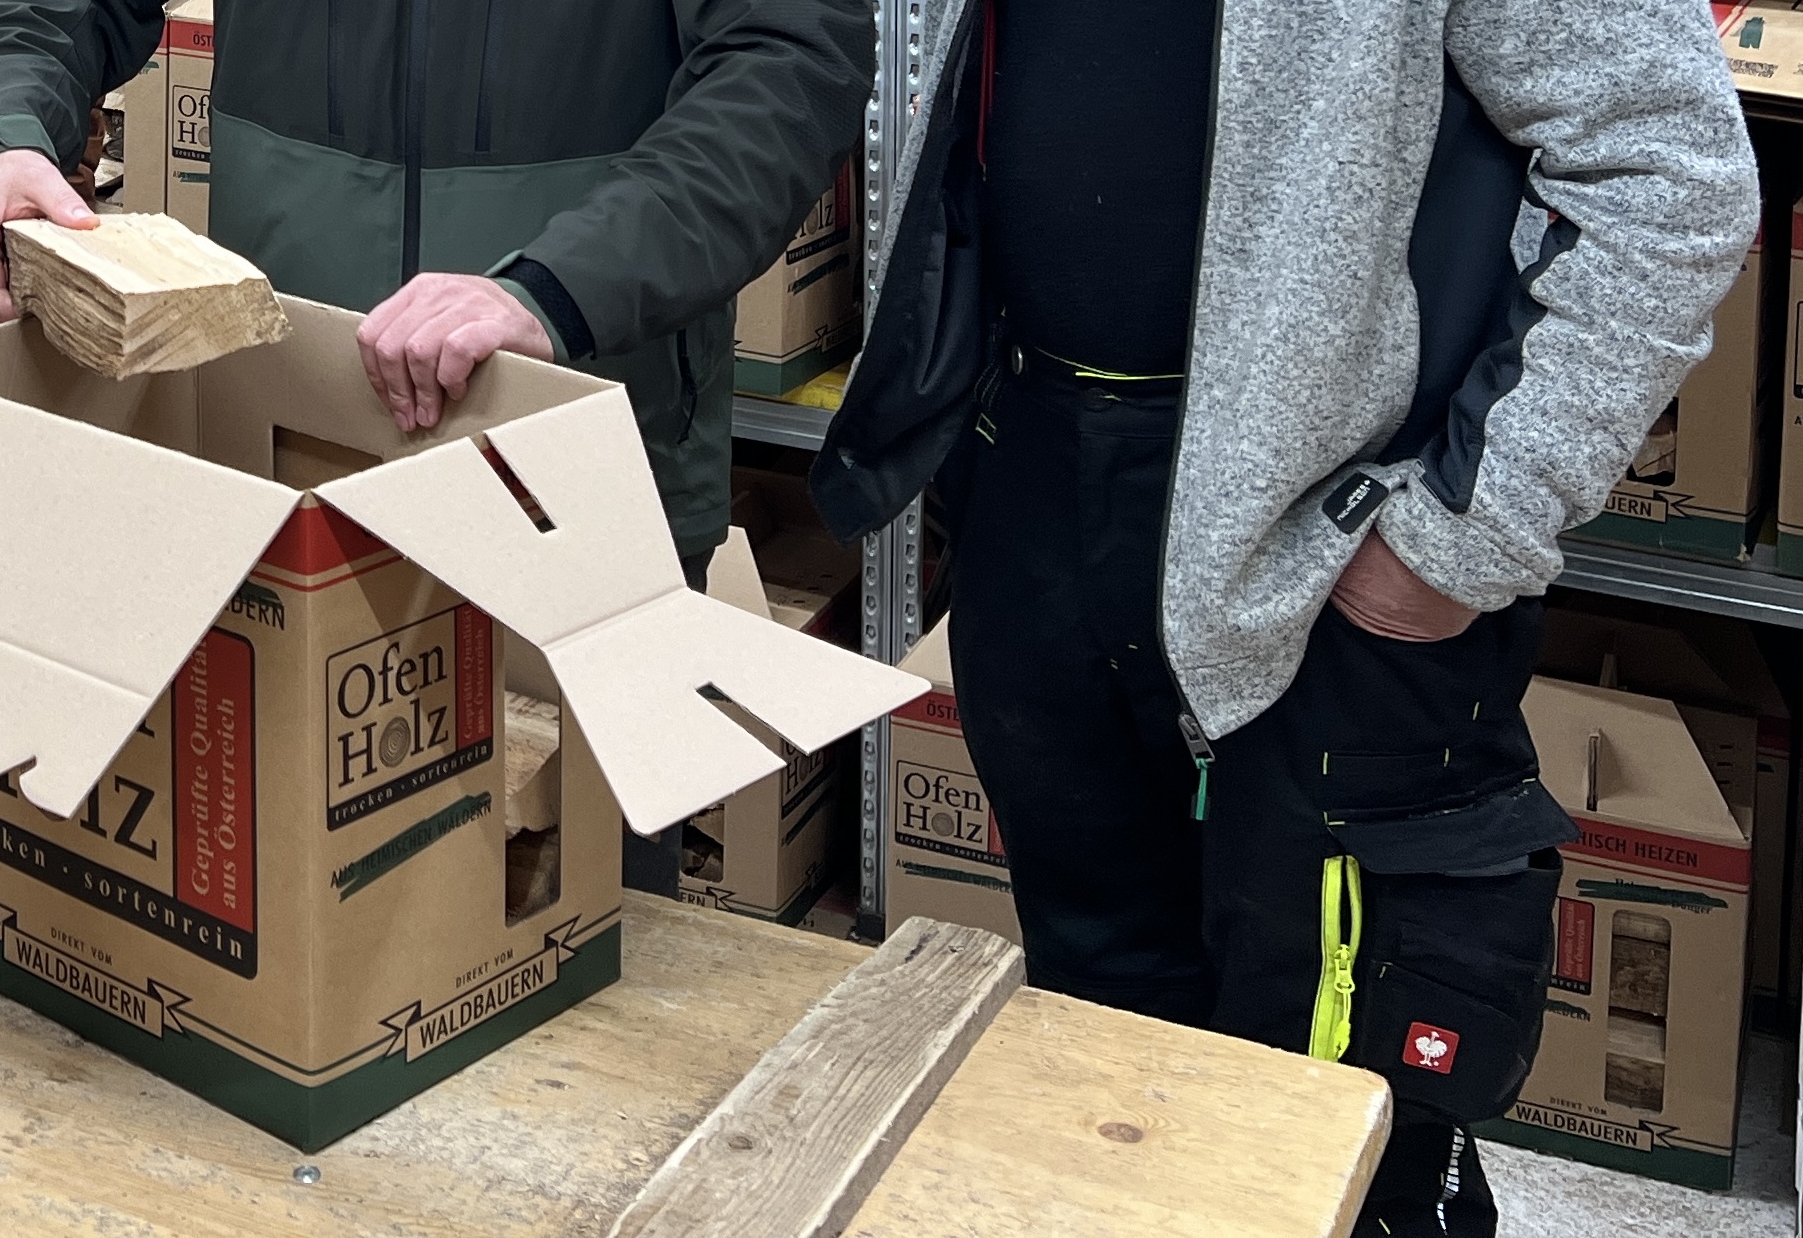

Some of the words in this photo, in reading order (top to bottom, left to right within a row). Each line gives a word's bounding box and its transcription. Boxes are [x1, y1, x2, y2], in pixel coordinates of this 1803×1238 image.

[337, 641, 447, 719] Ofen
[463, 663, 474, 740] Geprüfte
[476, 627, 487, 710] Österreich
[217, 698, 237, 853] Österreich
[338, 699, 449, 788] Holz
[334, 785, 394, 821] trocken
[411, 744, 489, 787] sortenrein
[904, 773, 983, 812] Ofen
[191, 766, 215, 896] Geprüfte
[903, 802, 983, 844] Holz
[1635, 842, 1698, 867] HEIZEN
[84, 872, 244, 960] sortenrein
[222, 865, 237, 908] aus
[16, 937, 146, 1024] WALDBAUERN
[50, 927, 86, 952] DIREKT
[91, 945, 113, 966] VOM
[455, 961, 491, 989] DIREKT
[493, 949, 514, 969] VOM
[419, 960, 544, 1047] WALDBAUERN
[1515, 1104, 1637, 1147] WALDBAUERN
[1549, 1096, 1582, 1112] DIREKT
[1588, 1104, 1607, 1115] VOM
